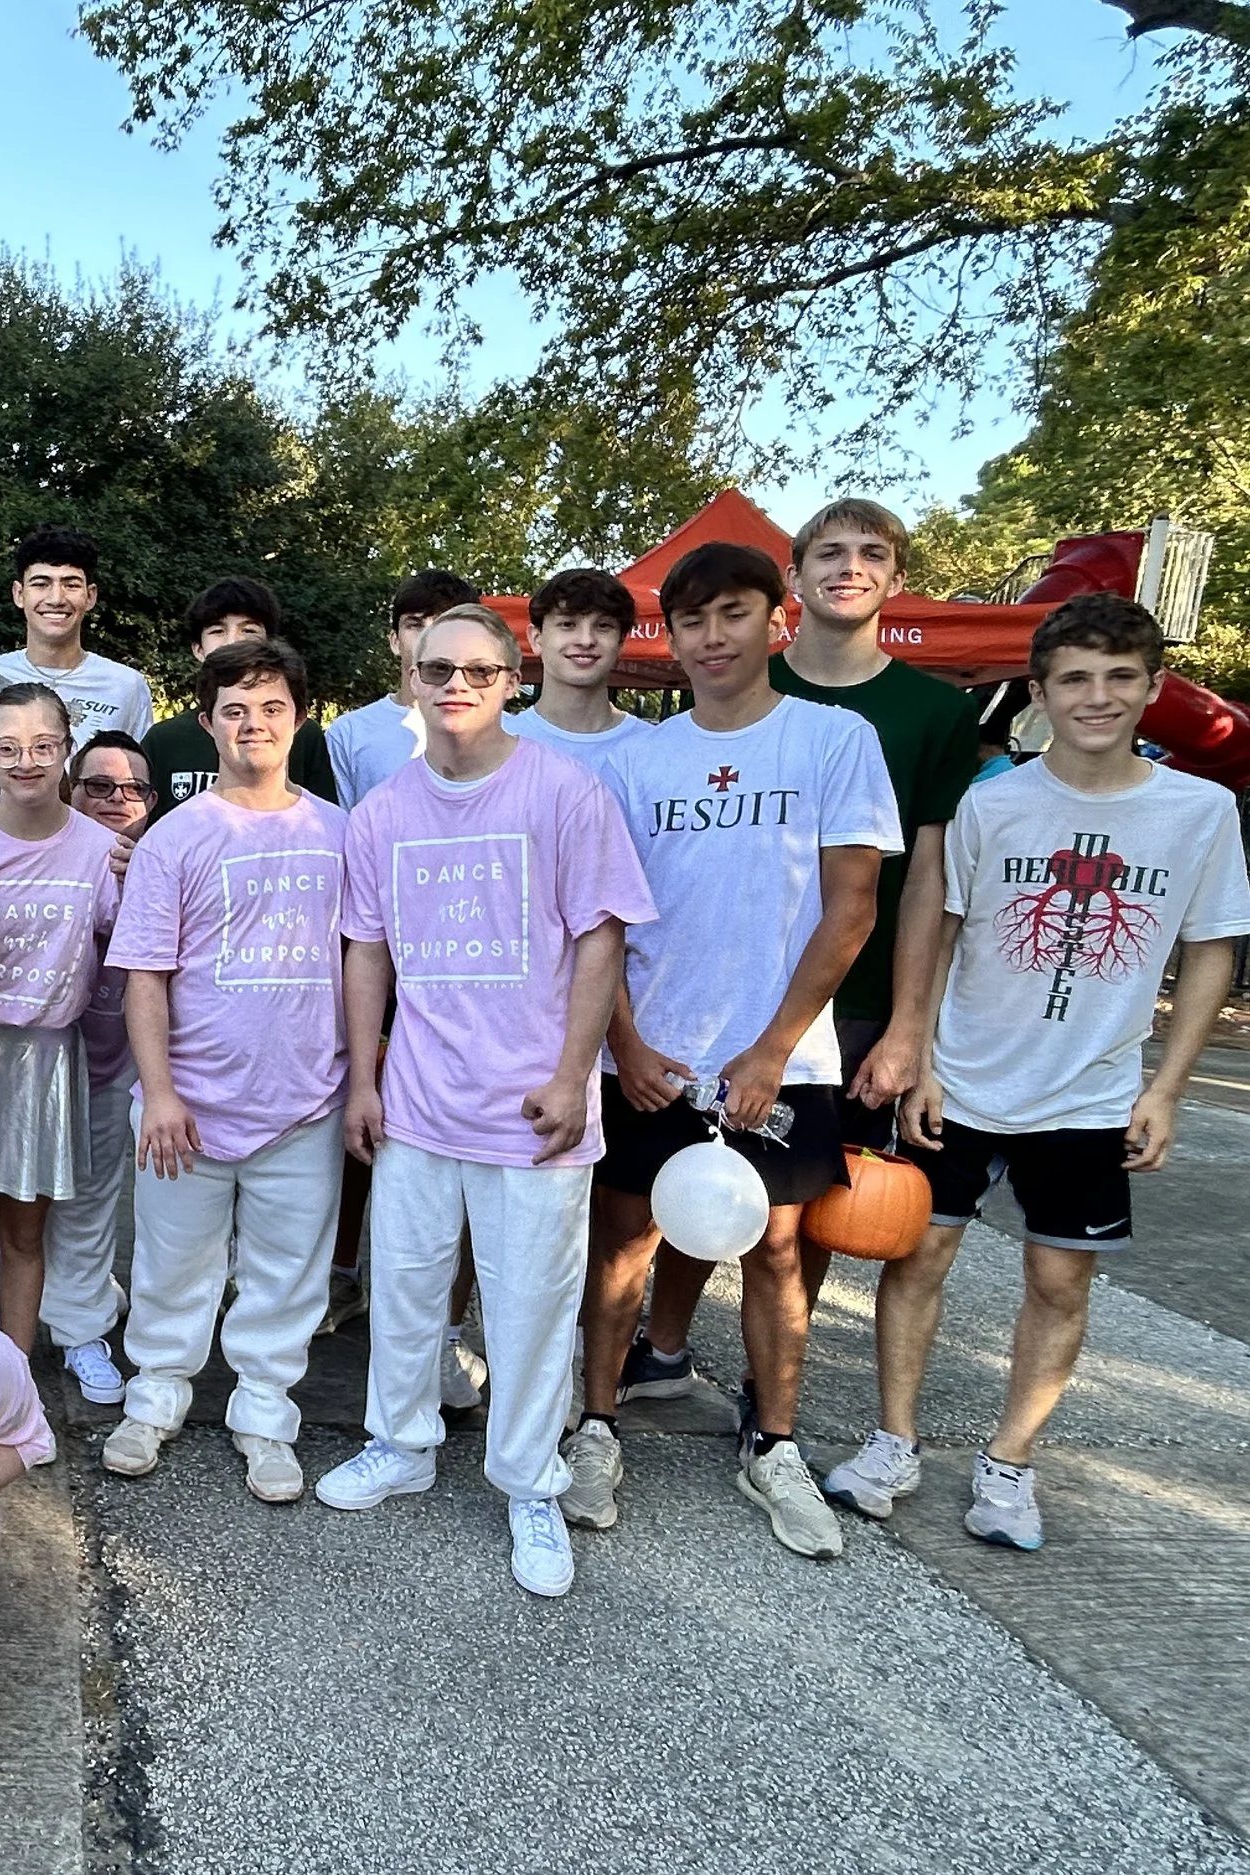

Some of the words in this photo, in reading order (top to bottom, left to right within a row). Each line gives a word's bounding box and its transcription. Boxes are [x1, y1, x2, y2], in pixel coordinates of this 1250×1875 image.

[880, 627, 922, 644] ING
[649, 790, 800, 838] JESUIT
[246, 874, 326, 897] DANCE
[415, 861, 503, 886] DANCE
[1001, 857, 1170, 897] AEROBIC
[261, 903, 310, 931] with
[223, 945, 321, 964] PURPOS
[403, 938, 520, 960] PURPOSE
